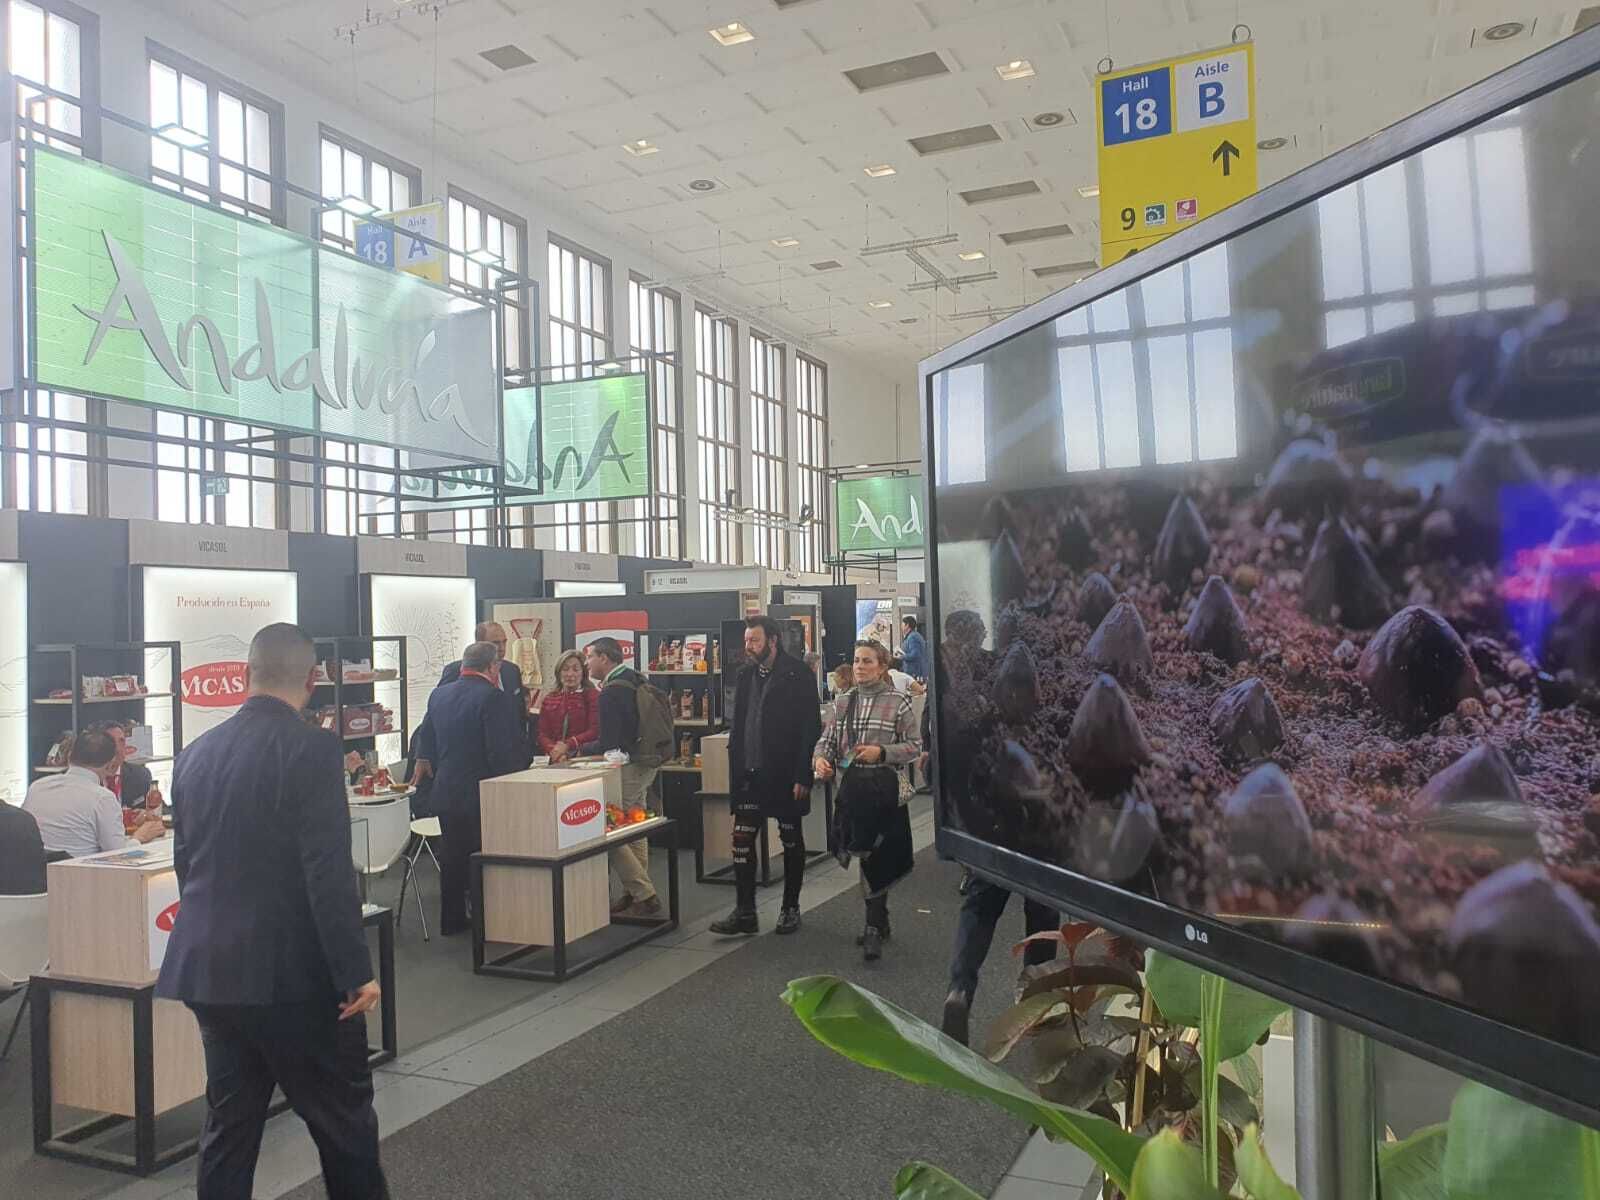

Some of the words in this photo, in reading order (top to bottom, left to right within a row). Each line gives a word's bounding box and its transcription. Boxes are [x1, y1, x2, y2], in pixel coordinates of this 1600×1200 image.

[1195, 61, 1229, 78] Aisle
[1122, 76, 1149, 94] Hall
[1199, 81, 1225, 119] B
[1115, 98, 1158, 134] 18
[1121, 207, 1136, 231] 9
[363, 240, 388, 264] 18
[408, 232, 428, 259] A
[848, 494, 923, 542] And
[198, 541, 228, 553] VICASOL
[177, 595, 225, 608] Producido
[226, 599, 238, 608] en
[1196, 929, 1208, 944] LG
